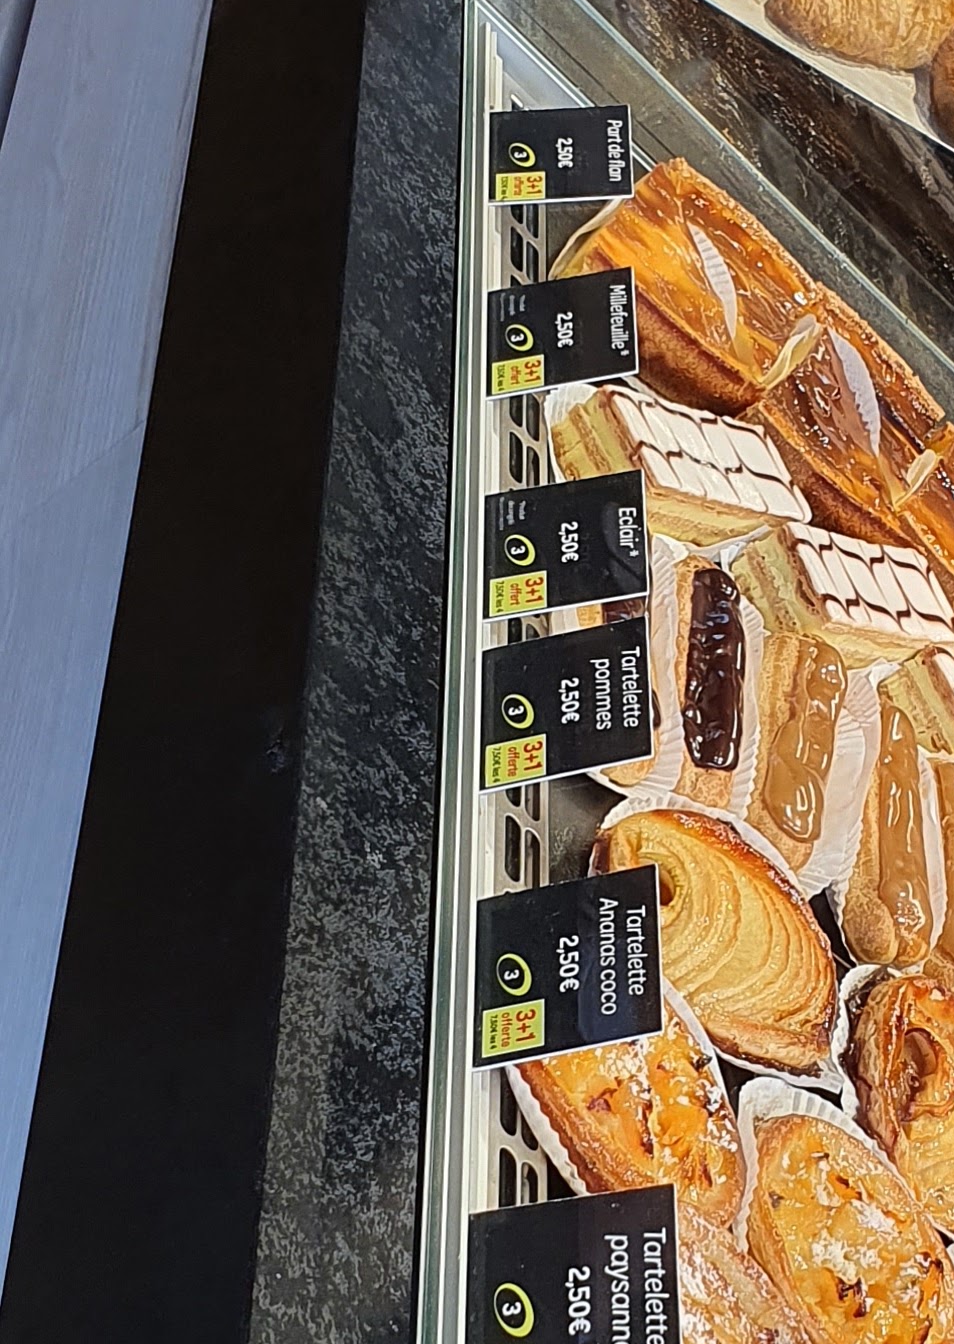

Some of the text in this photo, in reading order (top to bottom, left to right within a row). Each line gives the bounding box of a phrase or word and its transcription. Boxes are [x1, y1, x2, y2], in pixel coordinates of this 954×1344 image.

[555, 137, 574, 169] 2,50€
[606, 119, 627, 183] Part de flan
[526, 175, 543, 195] 3+1
[511, 333, 525, 343] 3
[555, 311, 574, 348] 2,50€
[524, 360, 541, 383] 3+1
[510, 545, 526, 555] 3
[558, 521, 580, 563] 2,50€
[510, 583, 522, 606] offert
[525, 577, 544, 603] 3+1
[558, 677, 580, 724] 2,50€
[589, 658, 612, 730] pommes
[621, 646, 643, 728] Tartelette
[507, 705, 525, 716] 3
[507, 746, 520, 777] offerte
[523, 741, 543, 771] 3+1
[556, 935, 580, 993] 2,50€
[599, 897, 619, 1015] Ananas coco
[626, 905, 649, 996] Tartelette
[504, 969, 520, 981] 3
[500, 1012, 513, 1048] offerte
[515, 1008, 536, 1043] 3+1
[502, 1301, 522, 1316] 3
[565, 1266, 591, 1336] 2,50€
